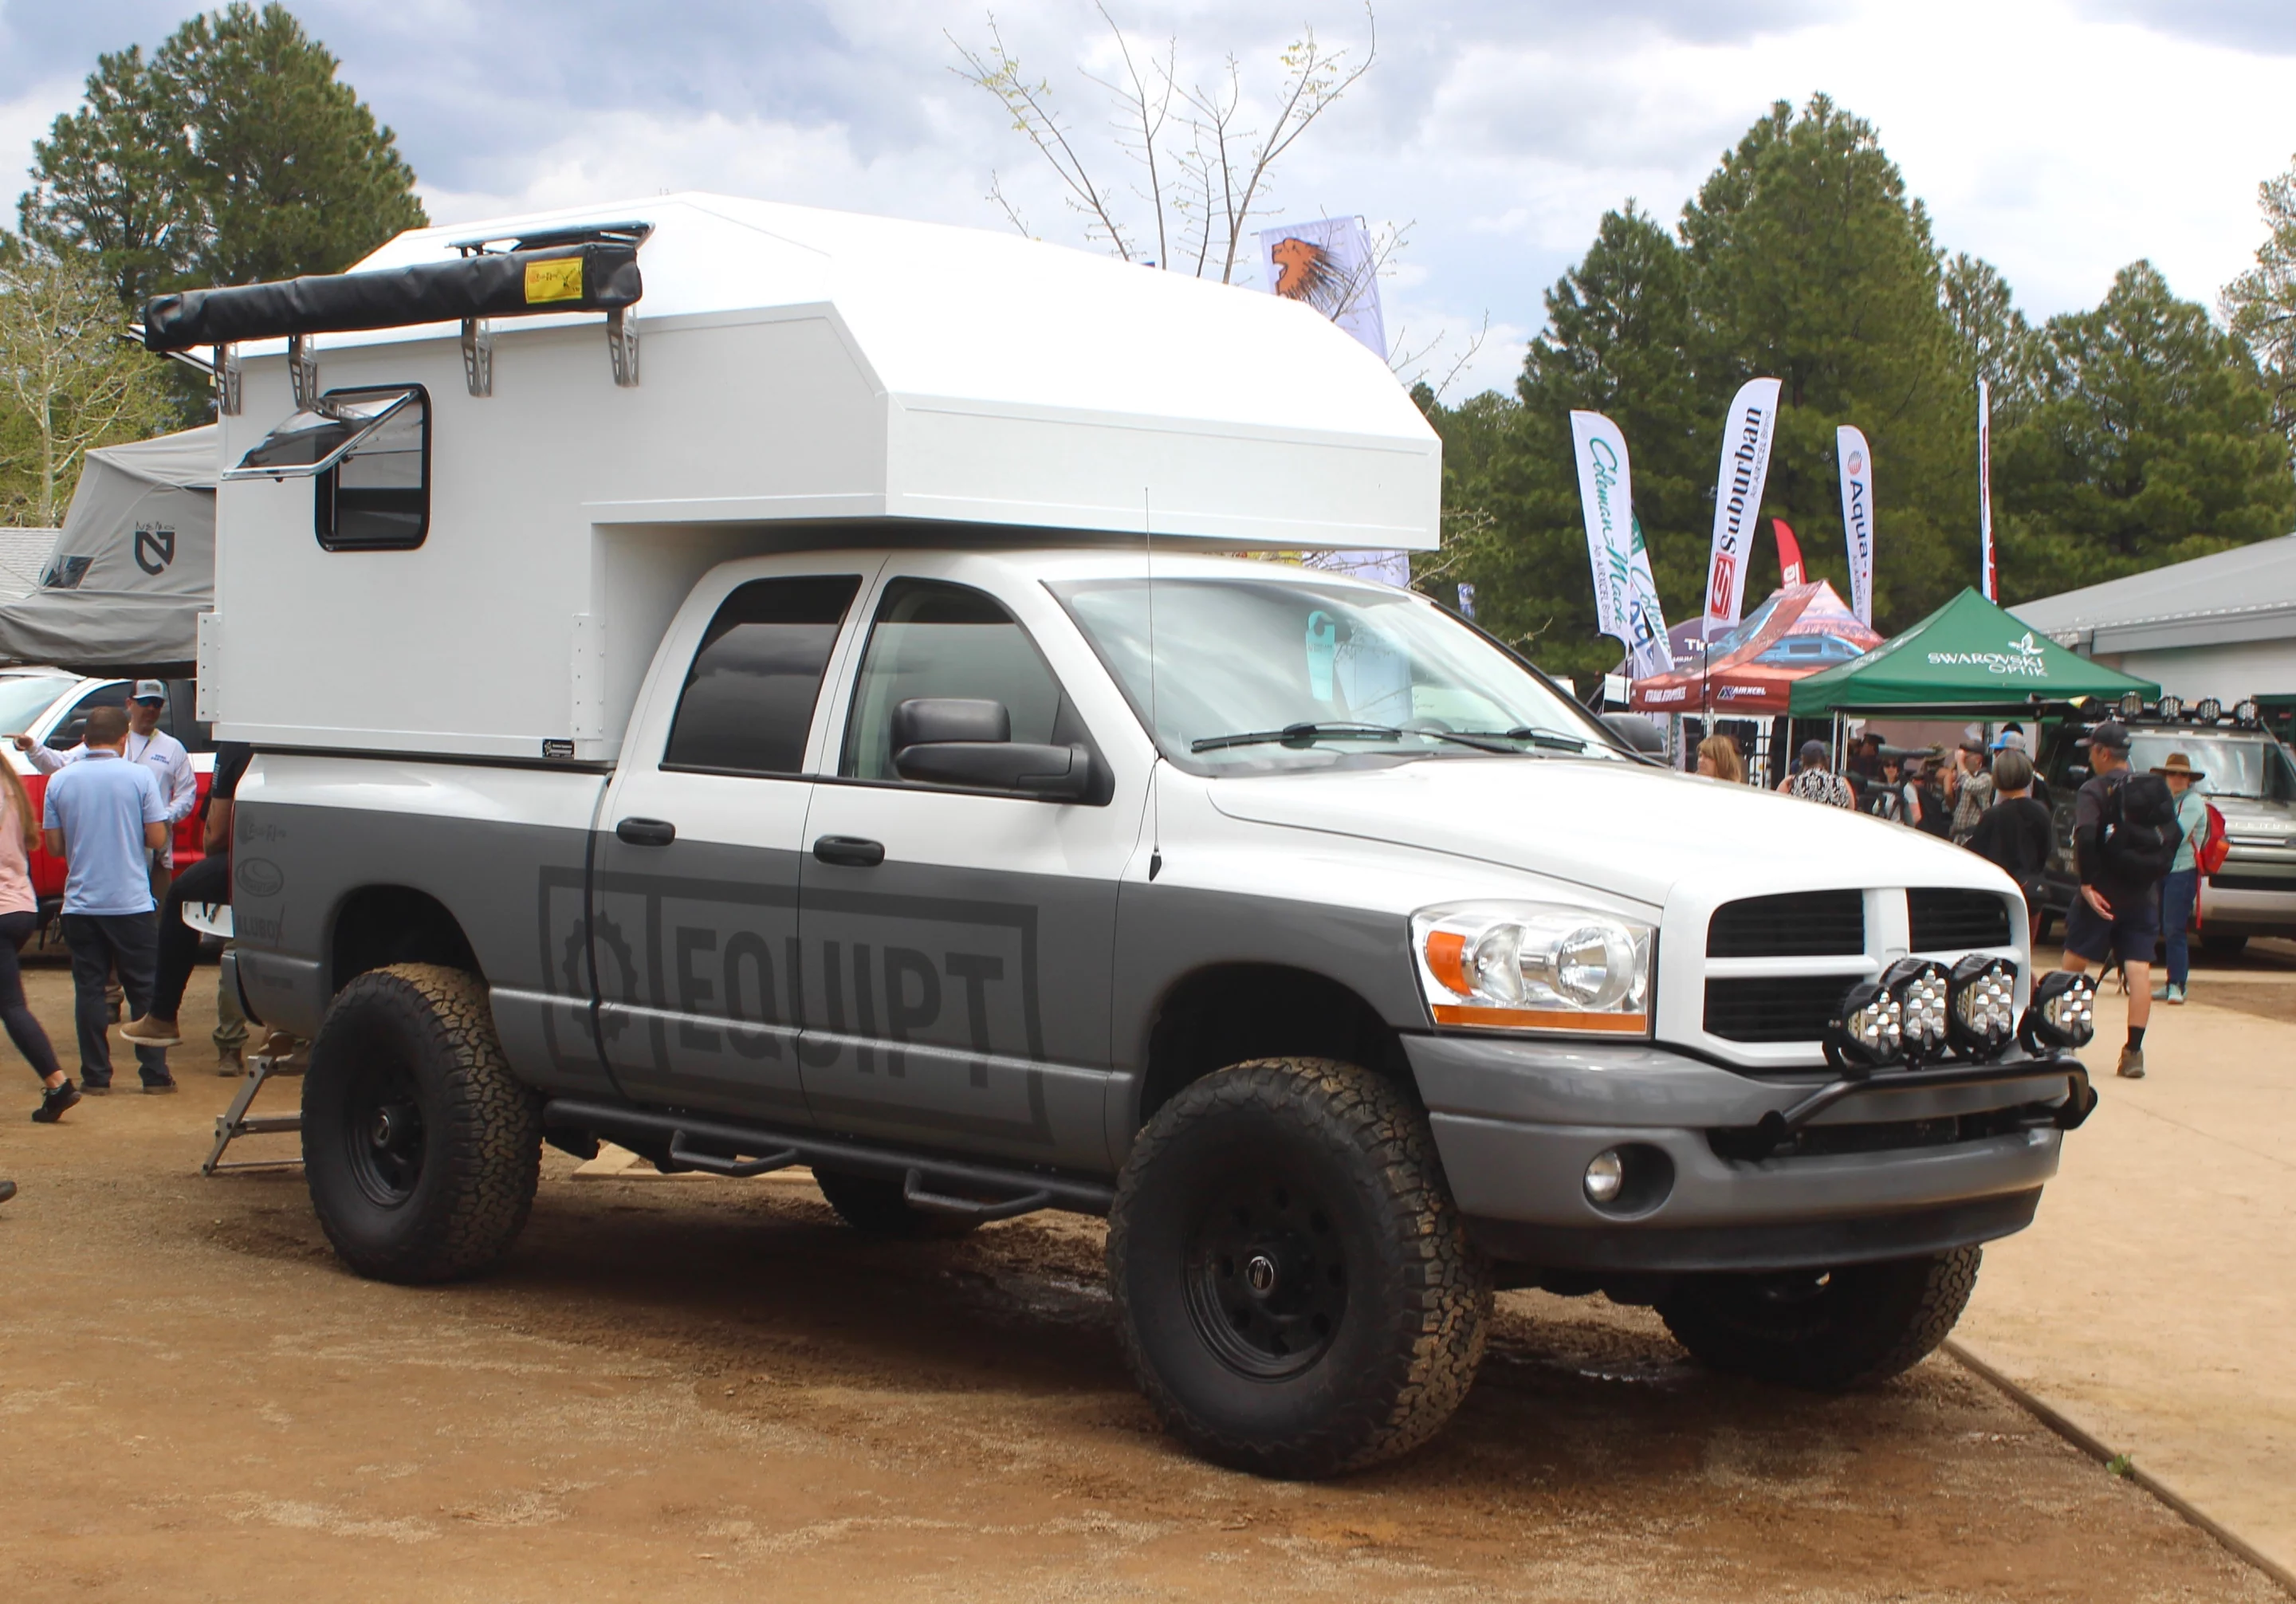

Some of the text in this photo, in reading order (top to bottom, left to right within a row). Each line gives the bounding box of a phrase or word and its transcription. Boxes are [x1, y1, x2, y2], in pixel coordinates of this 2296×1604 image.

[1720, 406, 1762, 555] Suburban
[1589, 437, 1629, 630] Coleman-Mack
[1732, 686, 1767, 695] AIRXCEL
[1928, 652, 2044, 667] SWAROVSKI
[1989, 663, 2048, 677] OPTIK
[675, 926, 1003, 1089] EQUIPT
